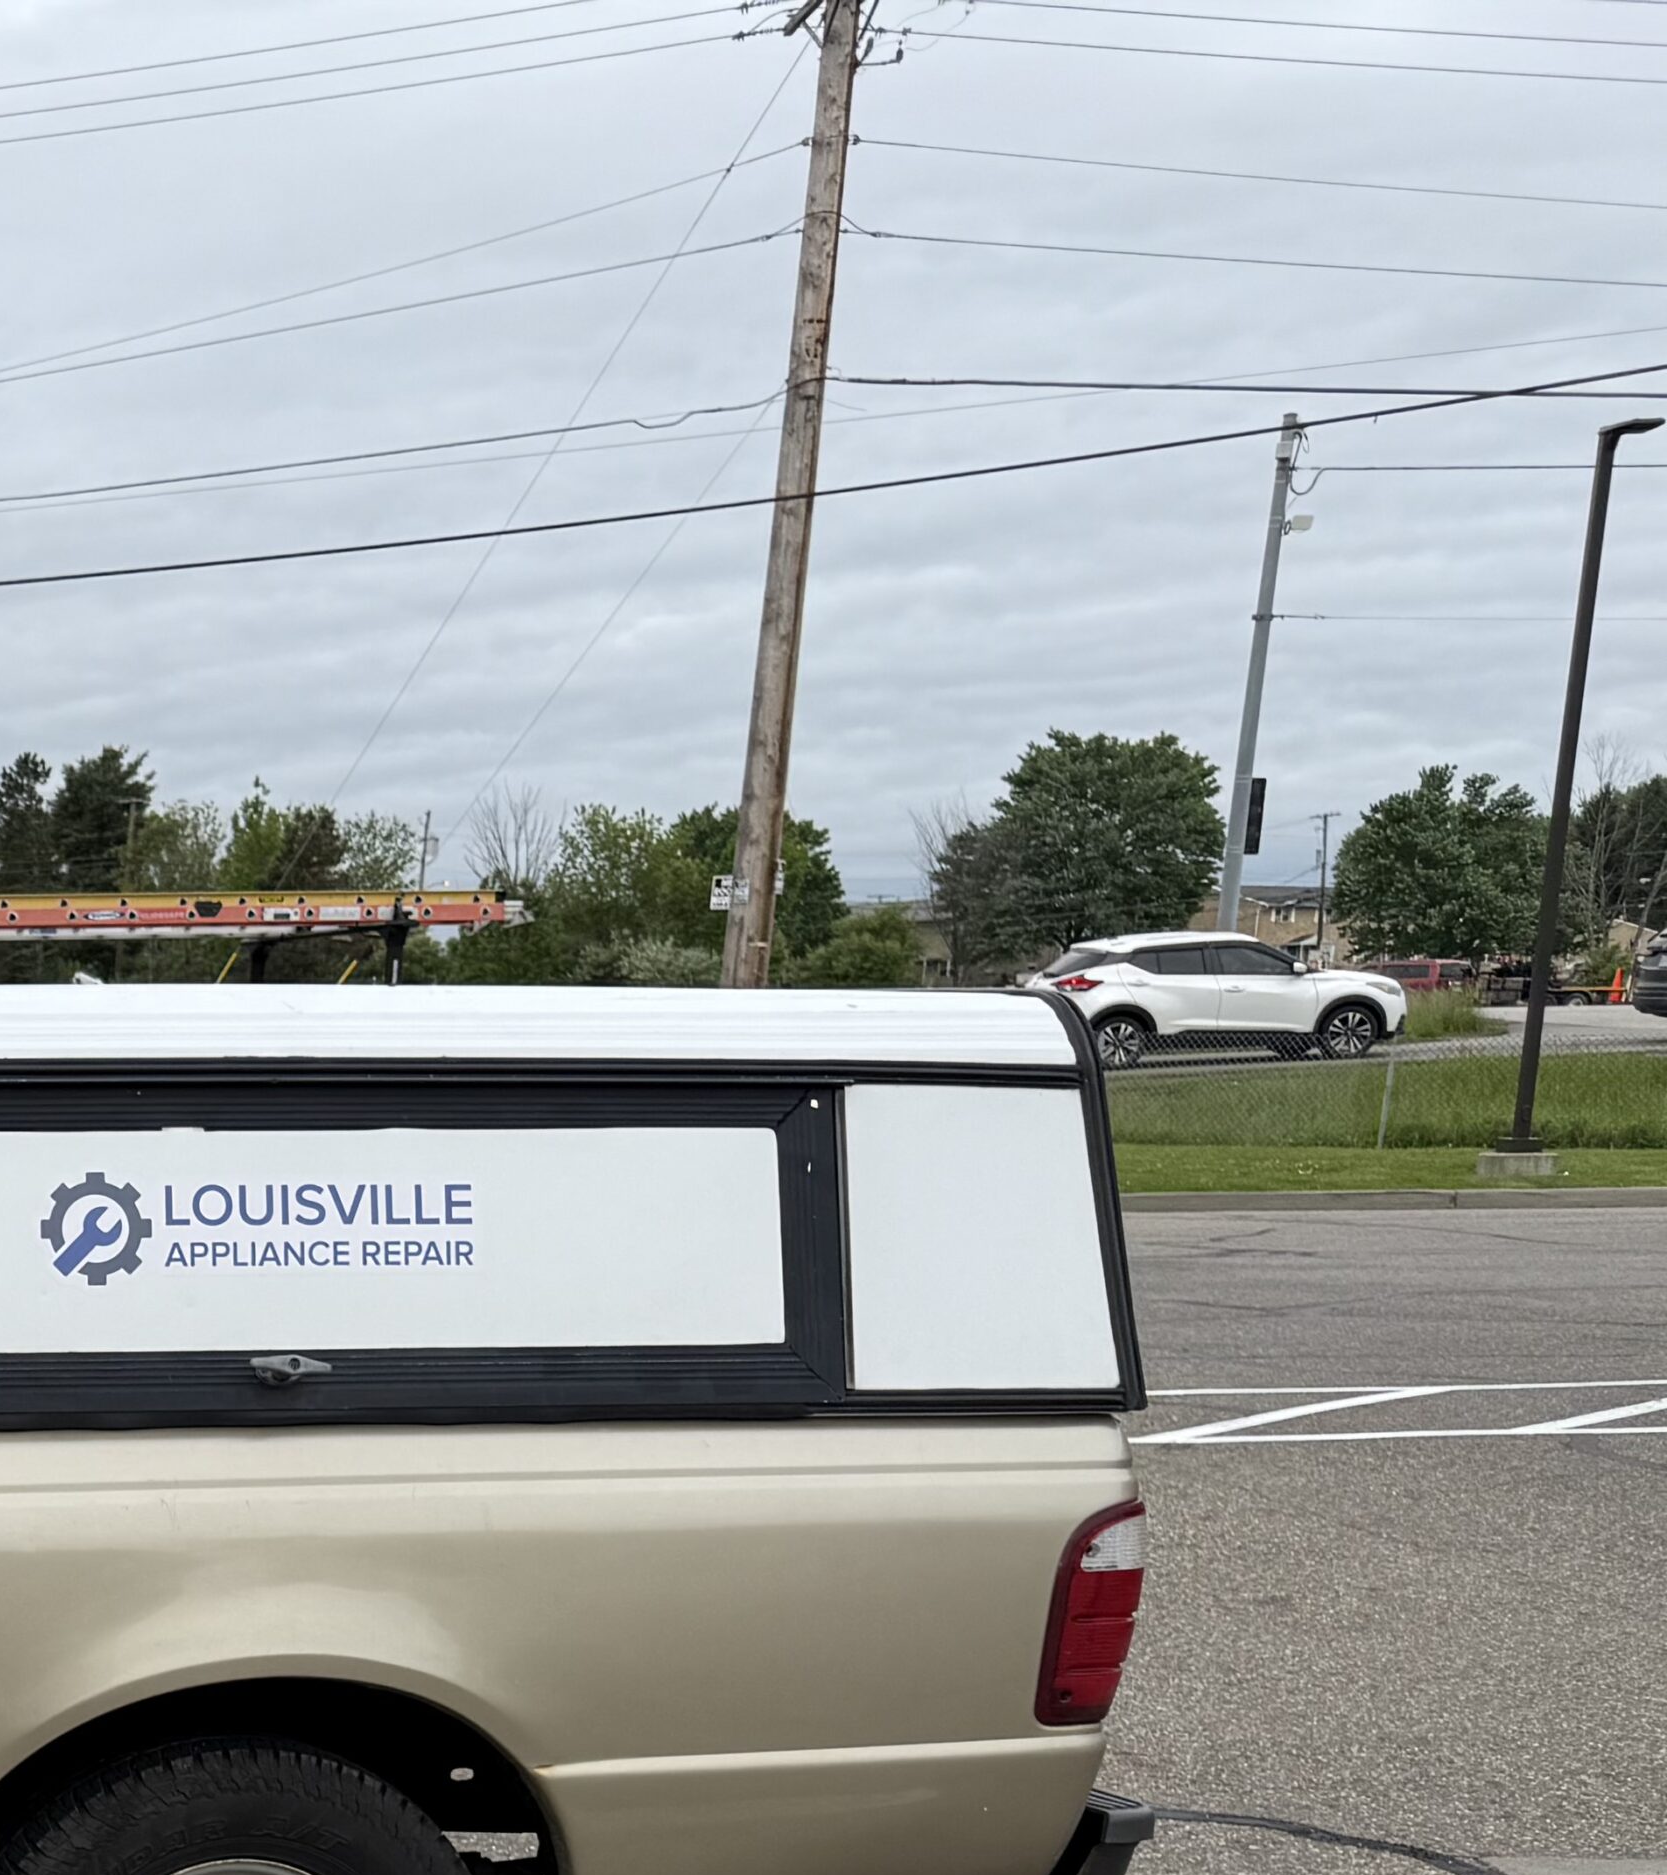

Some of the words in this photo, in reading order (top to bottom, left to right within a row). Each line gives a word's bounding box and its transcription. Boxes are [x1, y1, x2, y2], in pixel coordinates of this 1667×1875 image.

[164, 1183, 474, 1227] LOUISVILLE
[164, 1240, 351, 1268] APPLIANCE
[362, 1240, 475, 1267] REPAIR
